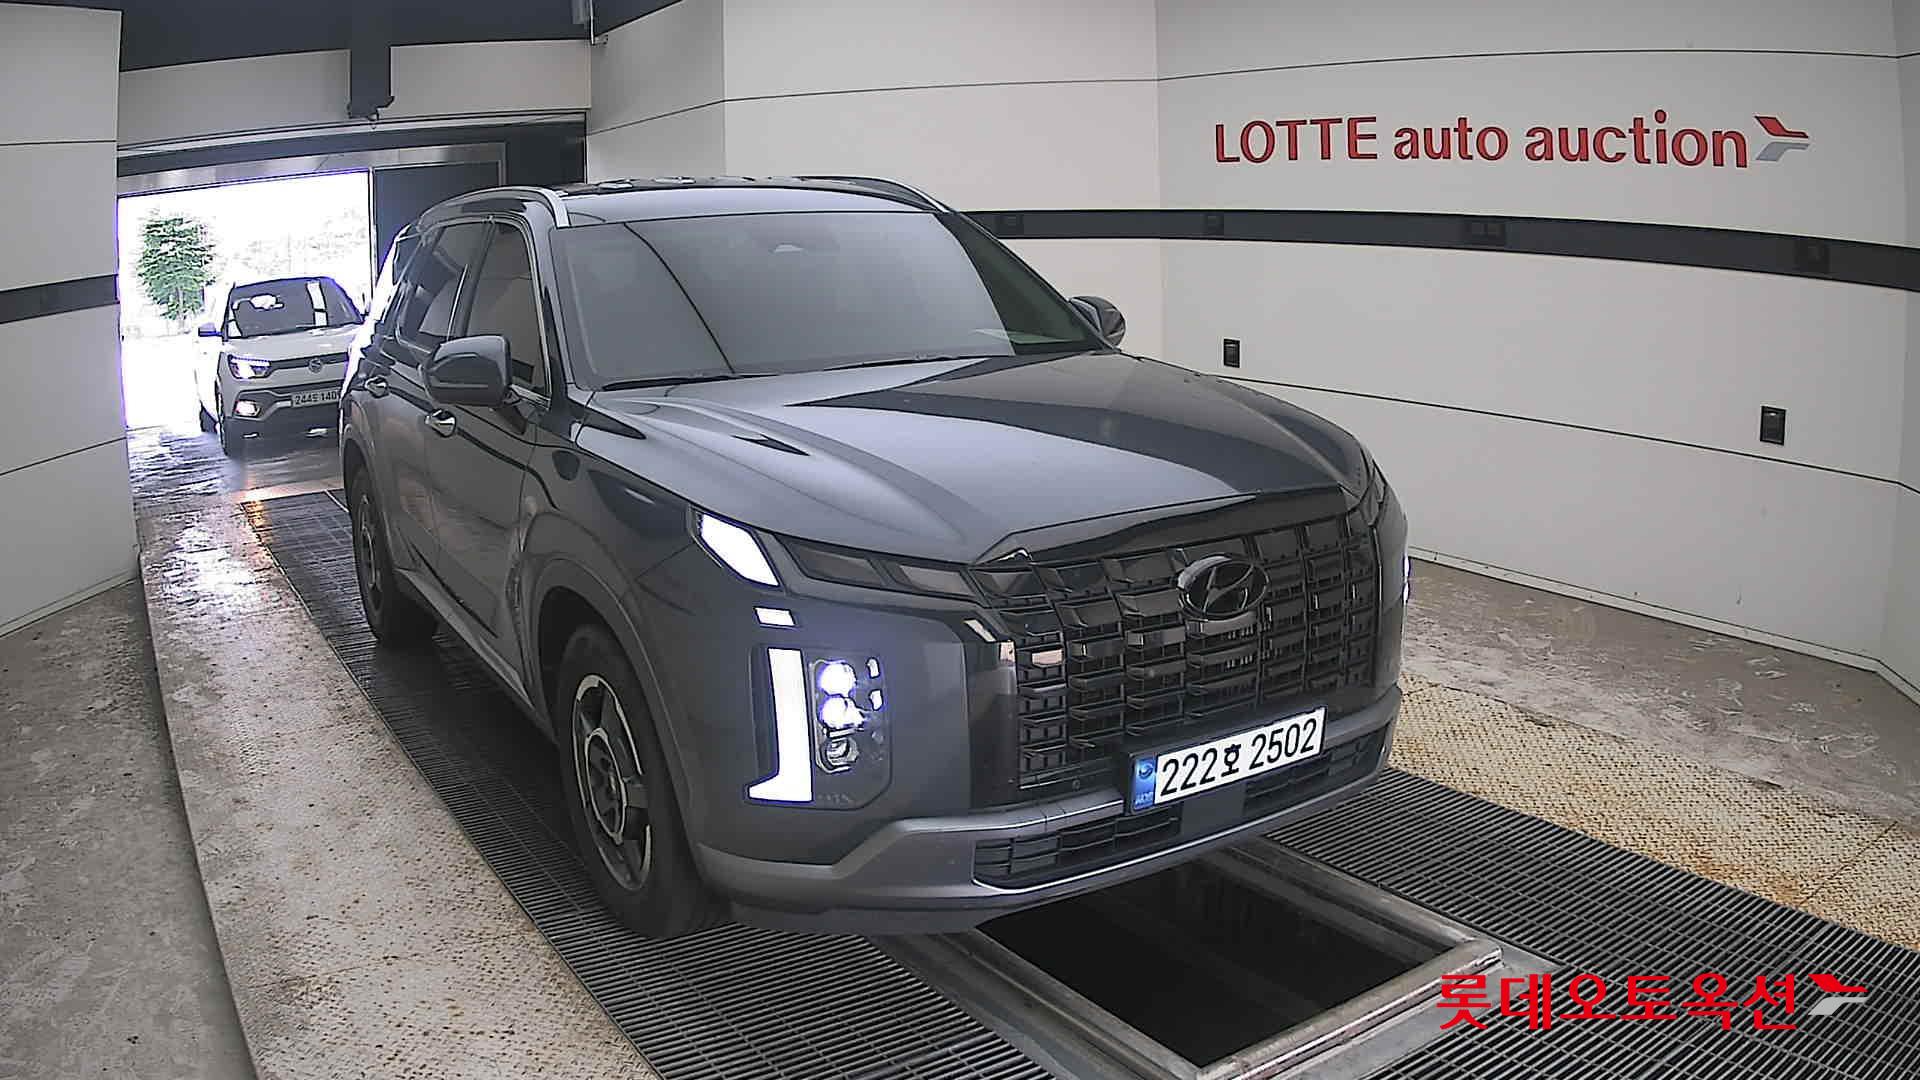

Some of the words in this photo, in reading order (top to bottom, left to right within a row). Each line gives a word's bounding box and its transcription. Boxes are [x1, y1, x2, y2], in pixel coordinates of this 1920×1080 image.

[1215, 116, 1377, 163] LOTTE
[1393, 116, 1509, 162] auto
[1524, 109, 1749, 169] auction
[1160, 743, 1242, 797] 222호
[1249, 718, 1317, 770] 2502
